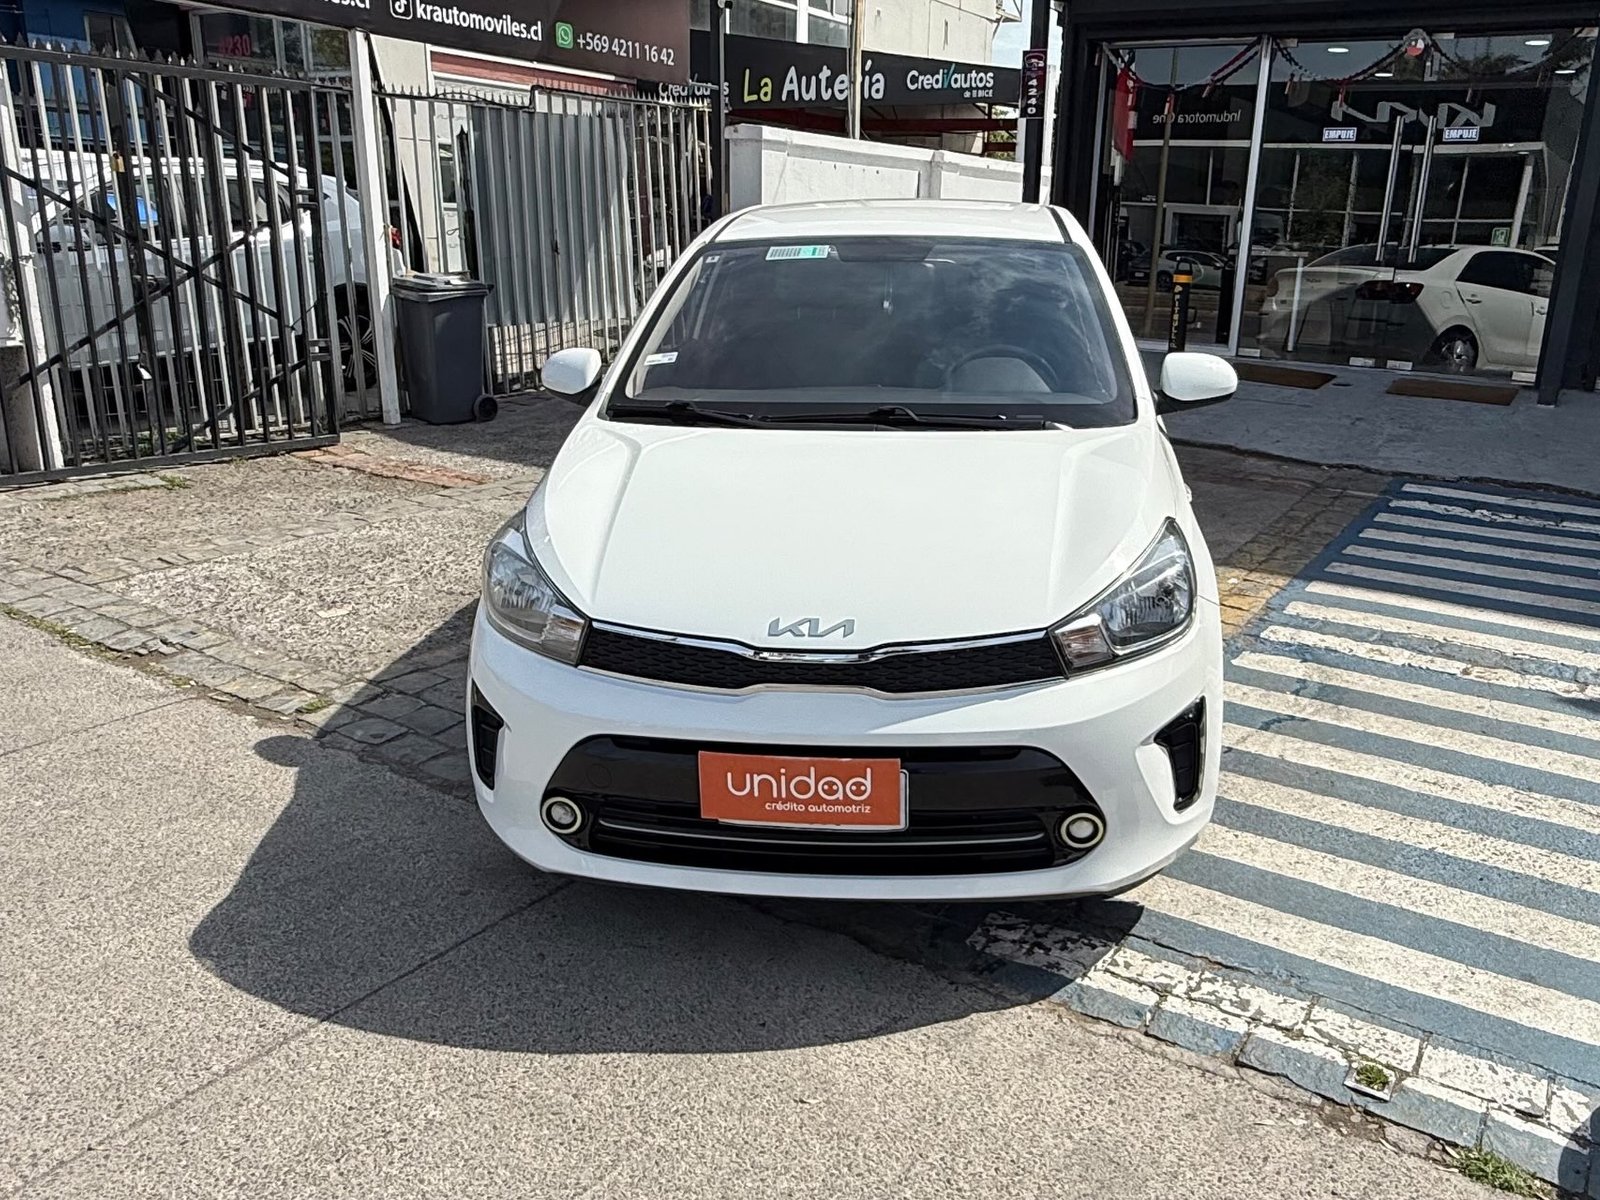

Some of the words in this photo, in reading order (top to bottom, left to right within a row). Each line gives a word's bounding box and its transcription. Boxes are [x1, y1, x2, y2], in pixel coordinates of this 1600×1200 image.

[416, 0, 542, 41] krautomoviles.cl
[577, 32, 609, 53] +569
[611, 38, 640, 59] 4211
[644, 44, 658, 63] 16
[660, 47, 675, 66] 42
[743, 68, 773, 103] La
[781, 59, 885, 102] Auteía
[1445, 129, 1478, 139] EMPUJE
[727, 766, 872, 800] unidad
[764, 800, 806, 812] crédito
[807, 803, 871, 814] automotriz
